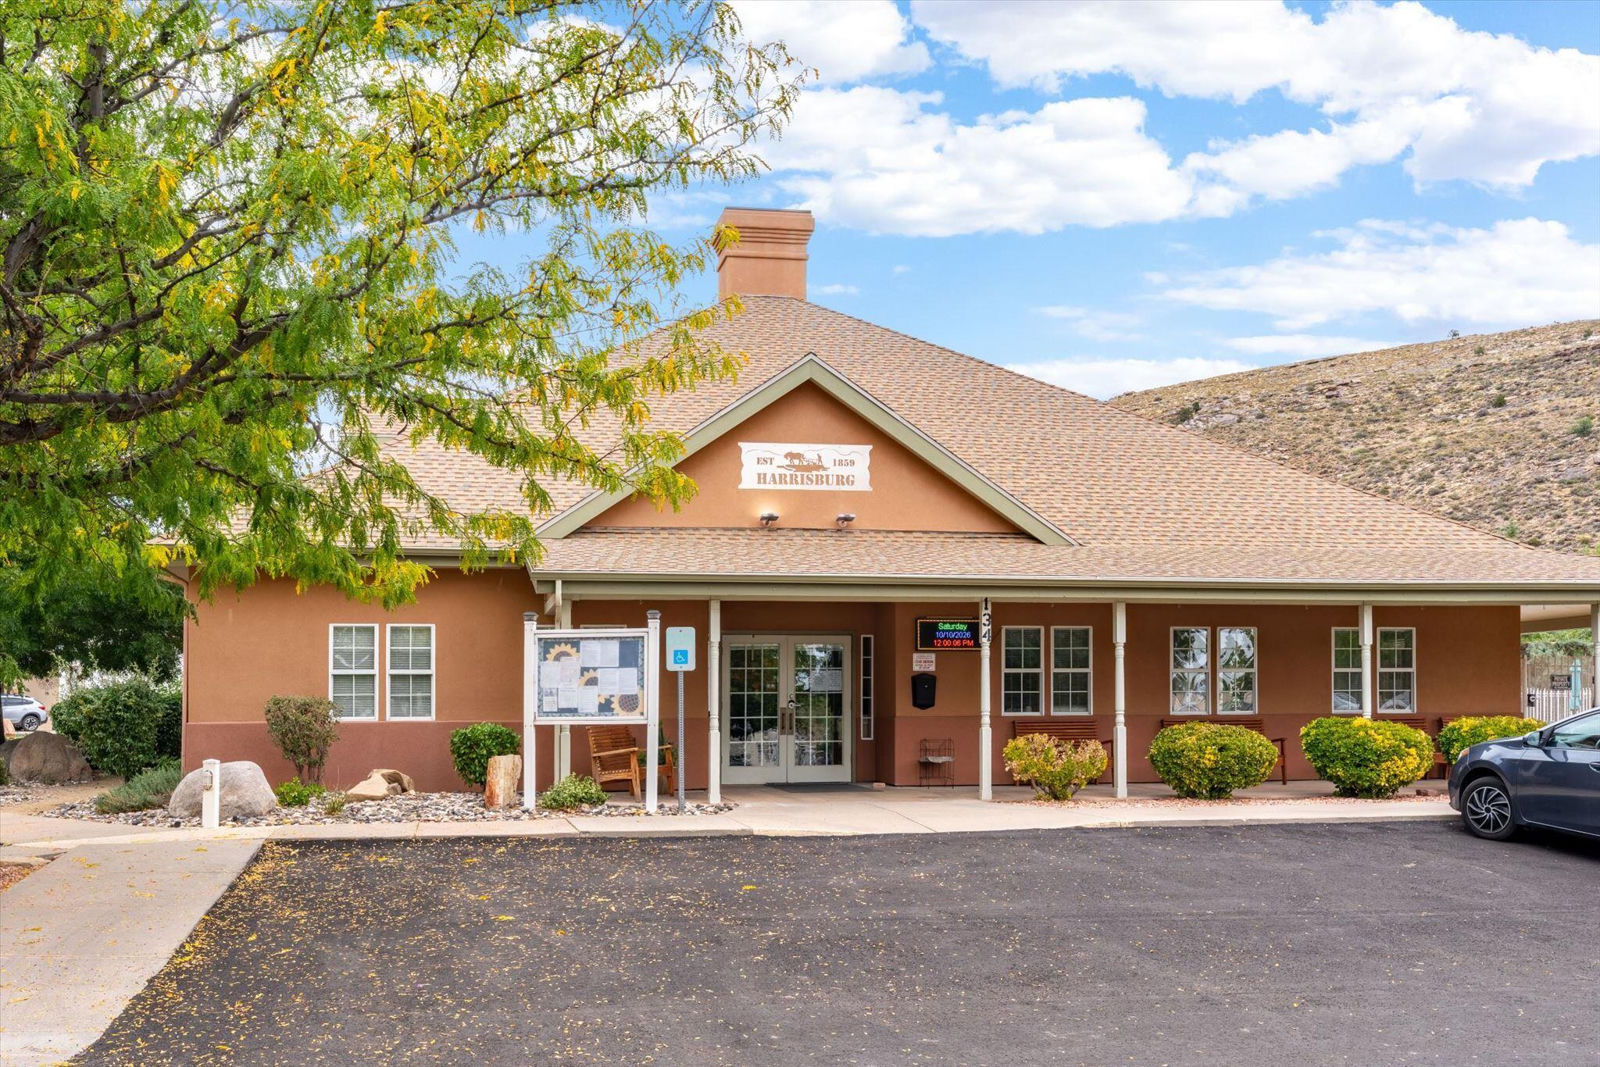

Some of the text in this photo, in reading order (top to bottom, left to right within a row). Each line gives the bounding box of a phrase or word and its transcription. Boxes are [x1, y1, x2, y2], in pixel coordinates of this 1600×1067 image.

[756, 457, 855, 467] EST 1859
[756, 473, 855, 486] HARRISBURG
[938, 622, 968, 630] Saturday
